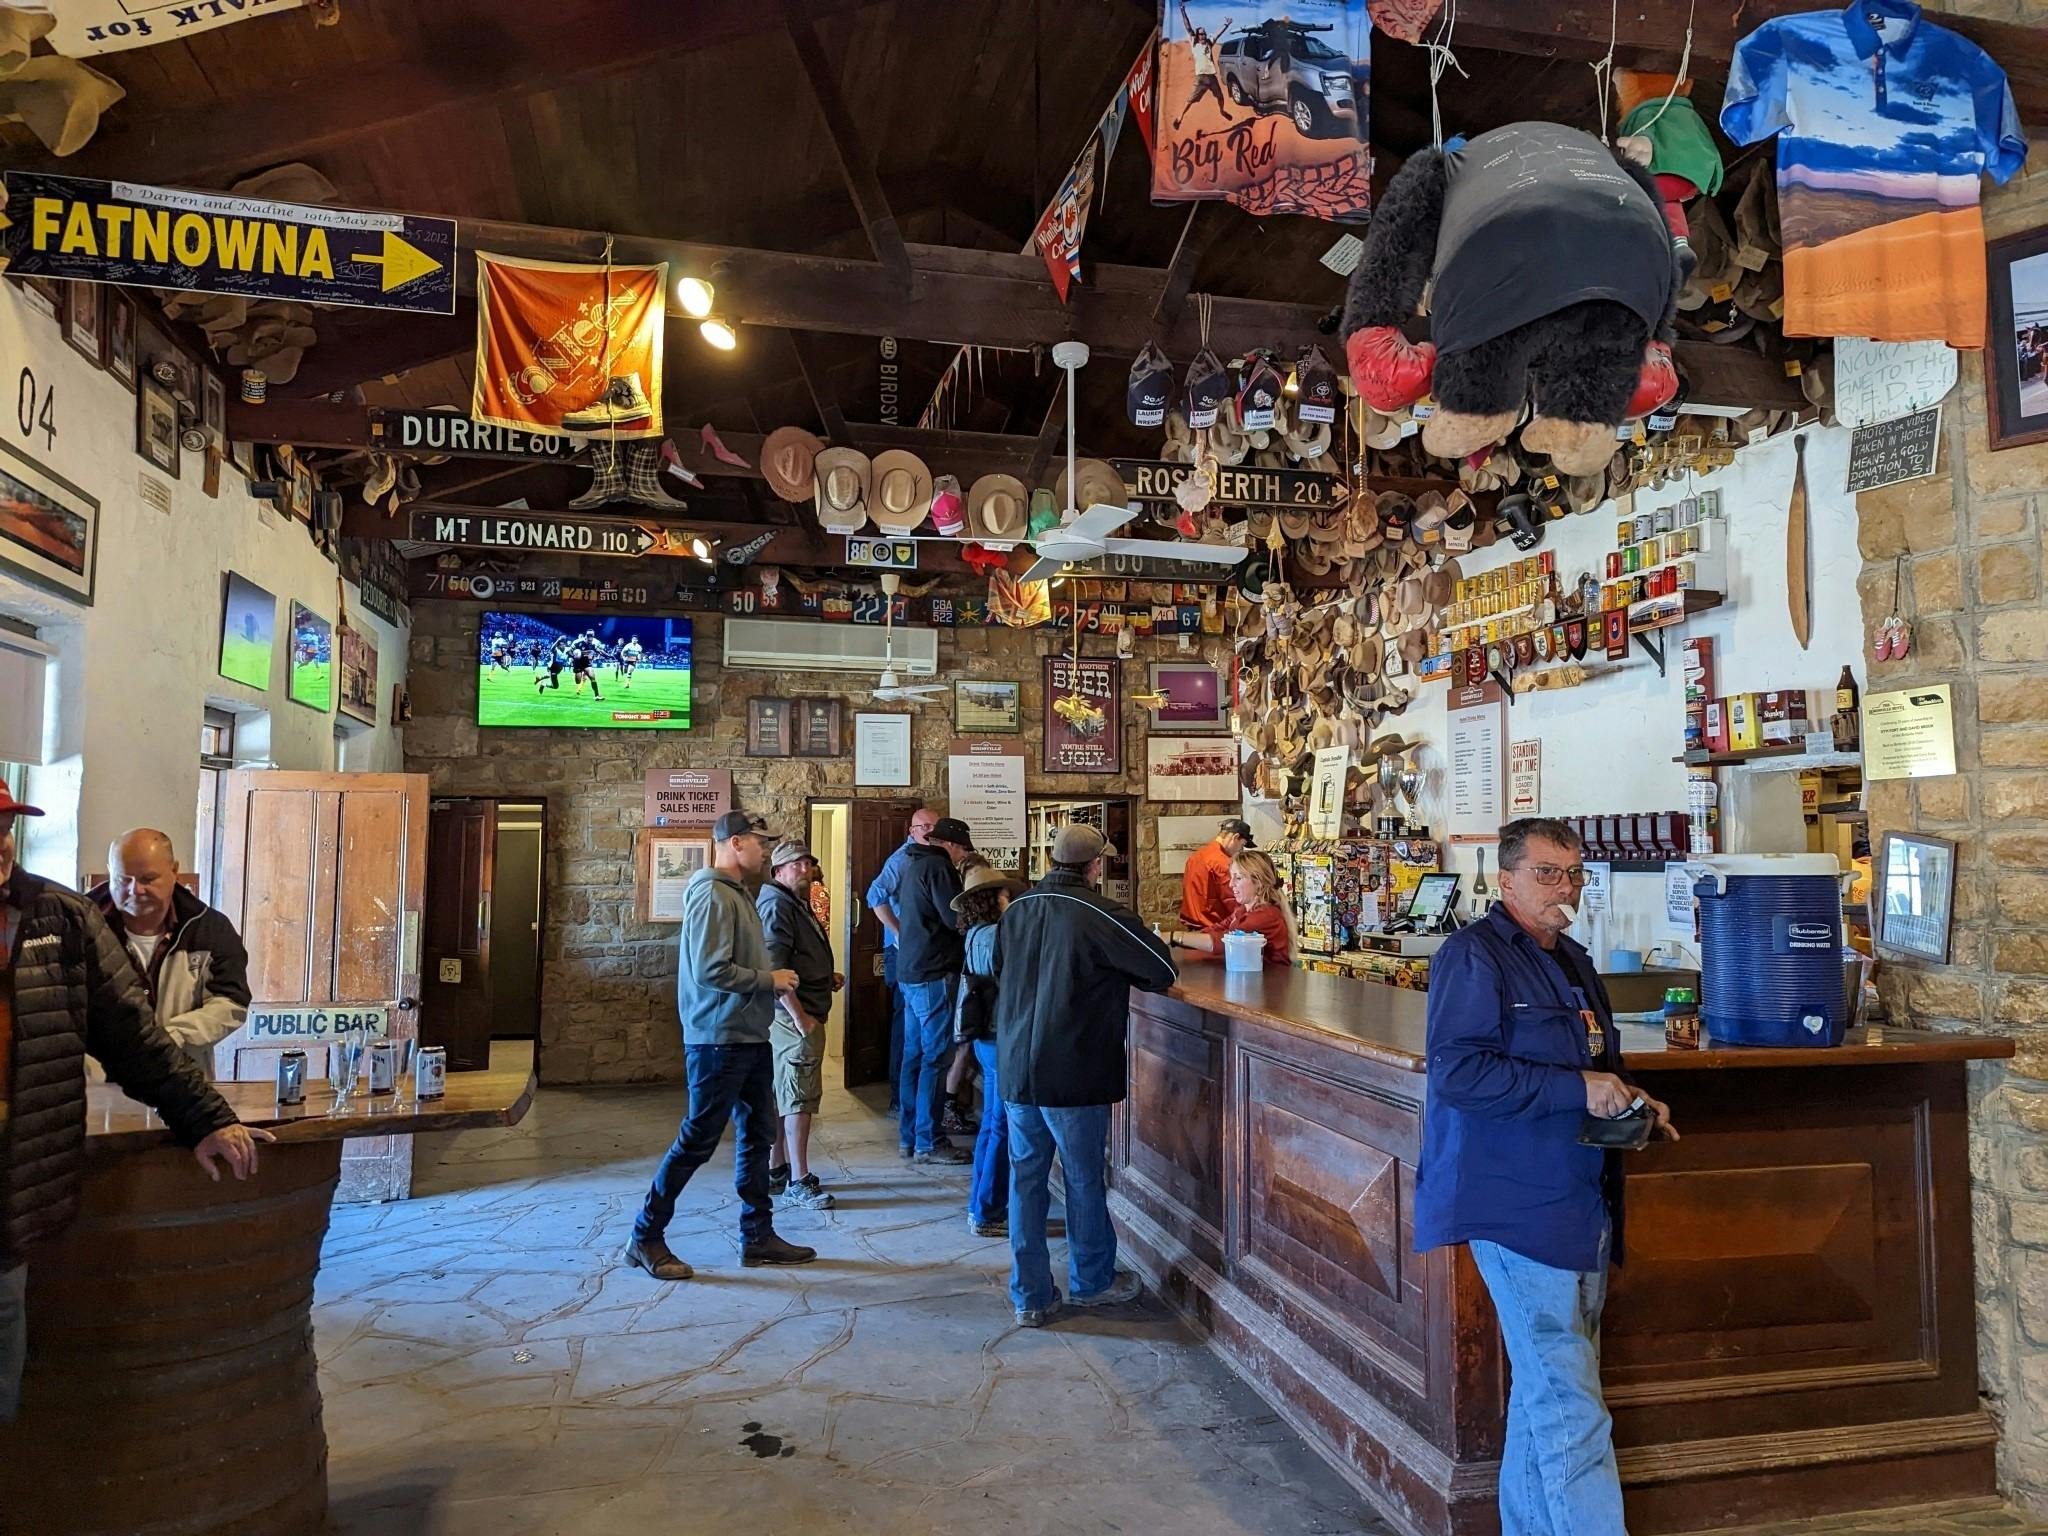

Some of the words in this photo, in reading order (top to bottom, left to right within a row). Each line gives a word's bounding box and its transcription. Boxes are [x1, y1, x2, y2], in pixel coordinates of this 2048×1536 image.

[1172, 137, 1223, 184] Big
[1227, 121, 1277, 177] Red
[139, 188, 198, 207] Darren
[203, 197, 233, 213] and
[238, 200, 295, 218] Nadine
[303, 211, 333, 223] 19th
[335, 215, 369, 228] May
[33, 197, 335, 280] FATNOWNA
[1876, 364, 1902, 384] TO
[18, 366, 57, 452] 04
[1907, 412, 1936, 427] VIDEO
[402, 415, 525, 453] DURRIE
[529, 435, 561, 455] 60
[1855, 438, 1885, 456] TAKEN
[1901, 424, 1933, 443] HOTEL
[1850, 459, 1902, 481] DONATION
[1907, 454, 1925, 465] TO
[1852, 451, 1886, 470] MEANS
[1890, 448, 1898, 460] A
[1137, 466, 1280, 502] ROSERTH
[1294, 481, 1321, 504] 20
[1849, 480, 1866, 492] THE
[481, 521, 593, 550] LEONARD
[602, 531, 628, 552] 110
[850, 542, 869, 561] 86
[732, 591, 755, 613] 50
[932, 611, 953, 623] 522
[1051, 605, 1070, 627] 12
[1076, 609, 1099, 630] 75
[1182, 611, 1200, 627] 67
[1053, 669, 1112, 699] BEER
[1763, 709, 1785, 719] Stanley
[1059, 751, 1106, 766] UGLY
[1512, 744, 1538, 759] STANDING
[1512, 760, 1523, 774] ANY
[1524, 758, 1538, 773] TIME
[656, 792, 686, 801] DRINK
[688, 792, 720, 801] TICKET
[660, 804, 689, 813] SALES
[692, 804, 716, 813] HERE
[1003, 859, 1019, 869] BAR
[254, 1013, 328, 1036] PUBLIC
[334, 1013, 380, 1034] BAR
